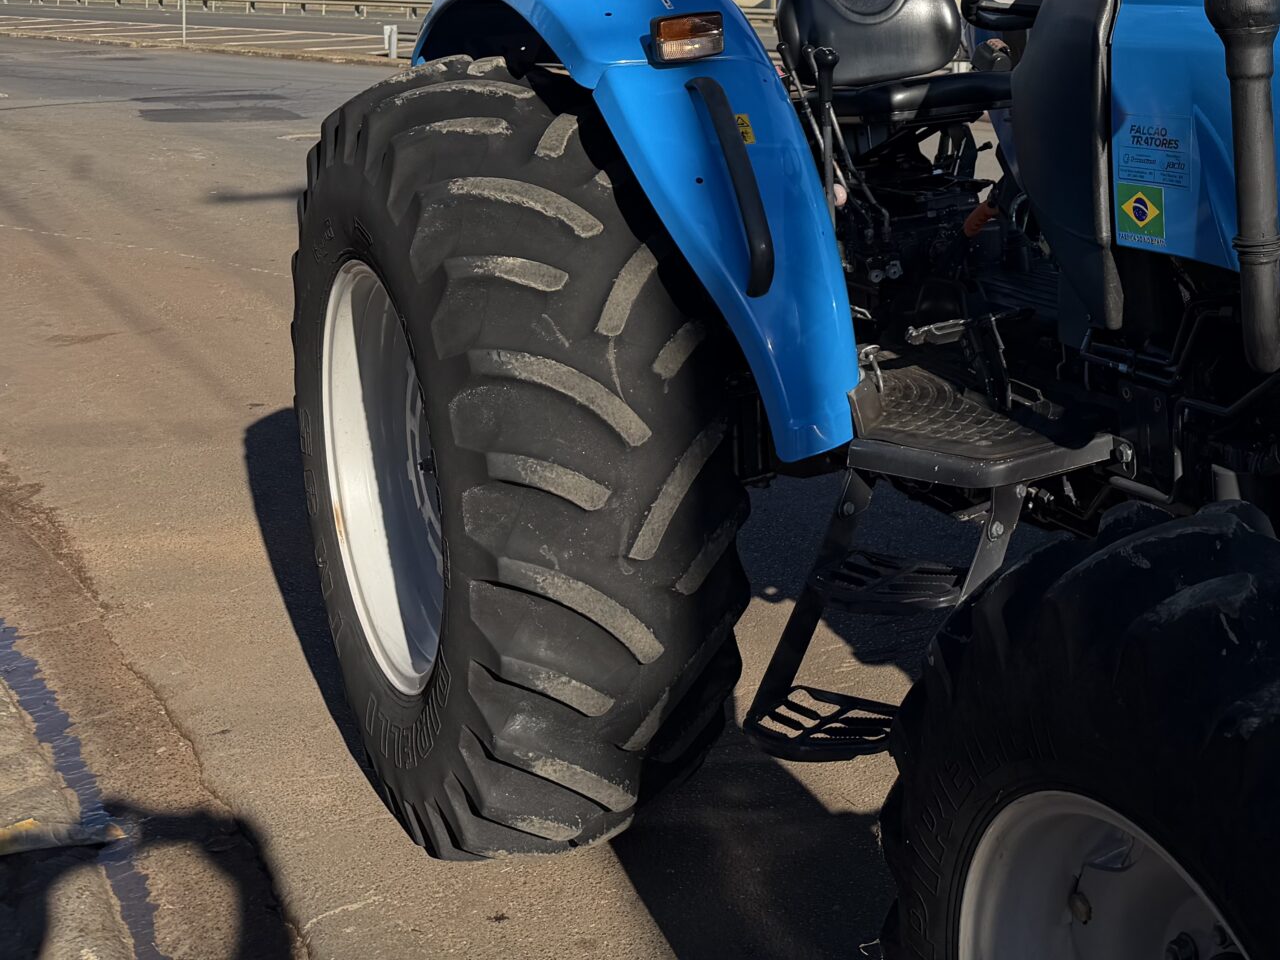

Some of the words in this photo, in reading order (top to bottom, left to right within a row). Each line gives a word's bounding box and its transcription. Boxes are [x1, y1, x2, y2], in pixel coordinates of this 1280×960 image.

[1130, 135, 1179, 150] TRATORES
[365, 644, 452, 770] PIRELLI
[902, 715, 1058, 960] PIRELLI
